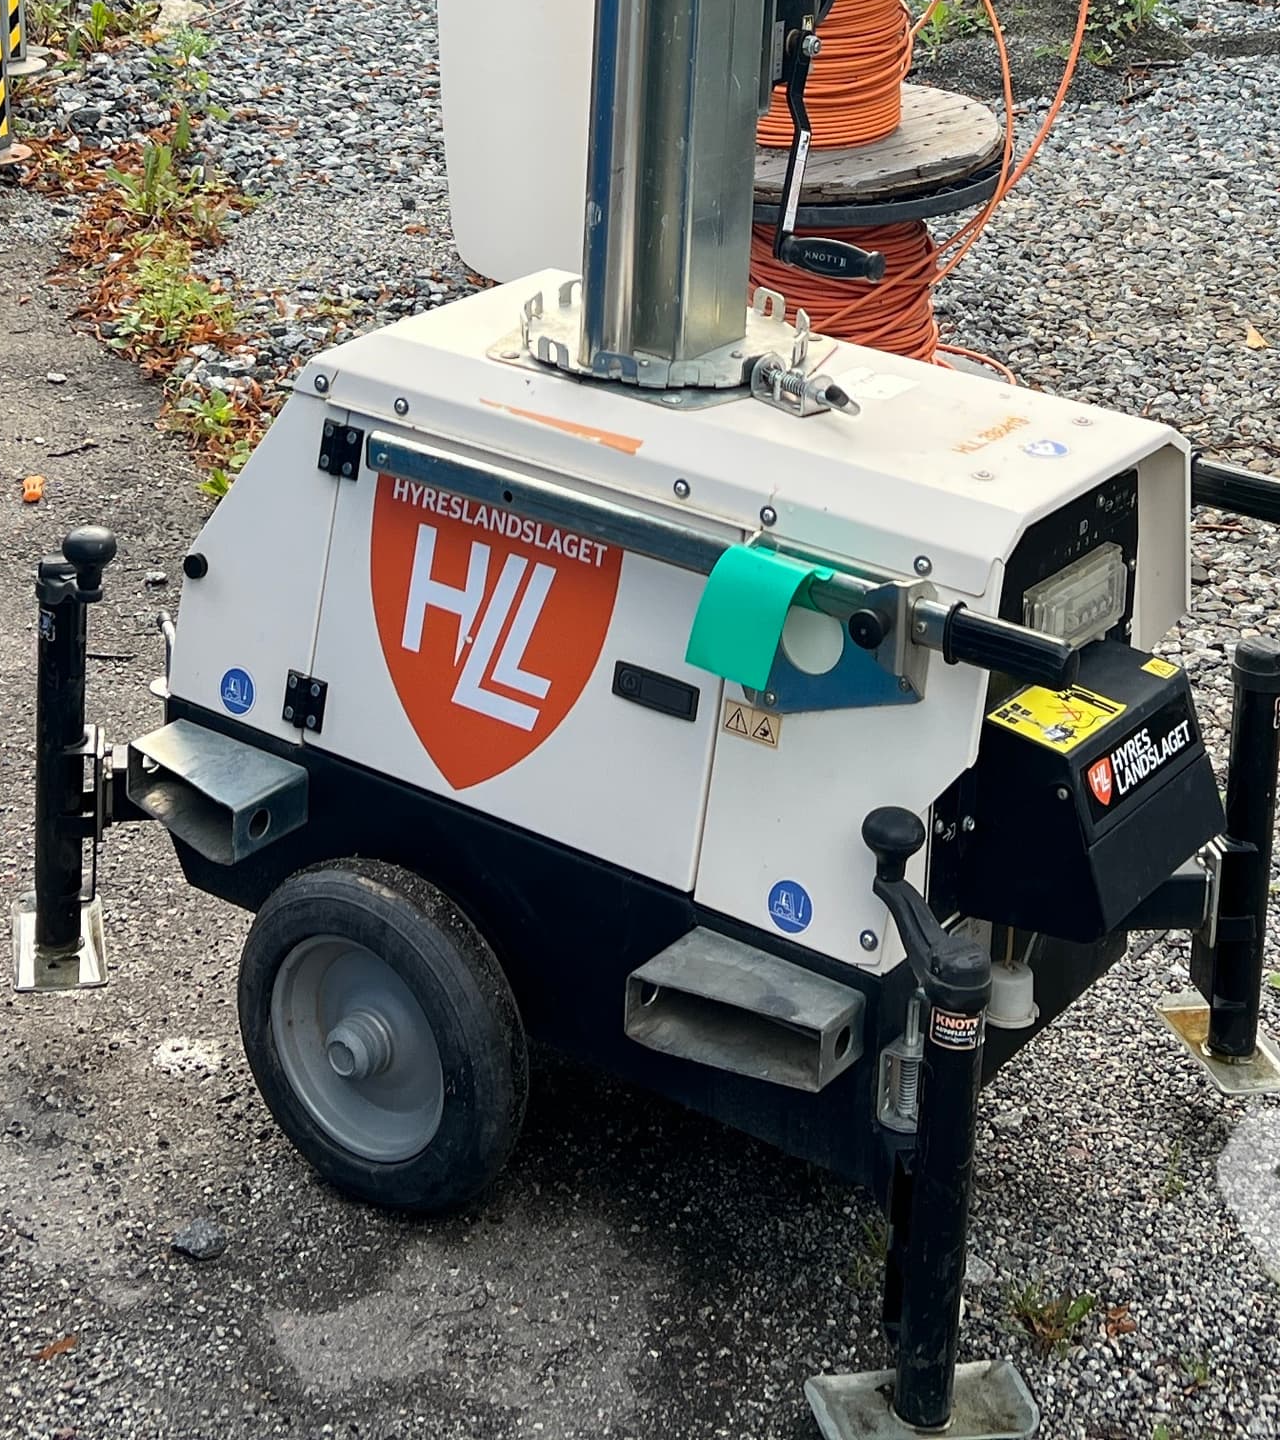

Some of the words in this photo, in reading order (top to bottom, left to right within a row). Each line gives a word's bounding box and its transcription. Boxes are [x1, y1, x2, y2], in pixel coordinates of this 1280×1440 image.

[393, 478, 608, 568] HYRESLANDSLAGET
[401, 522, 558, 733] HLL
[1110, 728, 1152, 774] HYRES
[1116, 720, 1190, 795] LANDSLAGET
[936, 1012, 979, 1030] KNOTT
